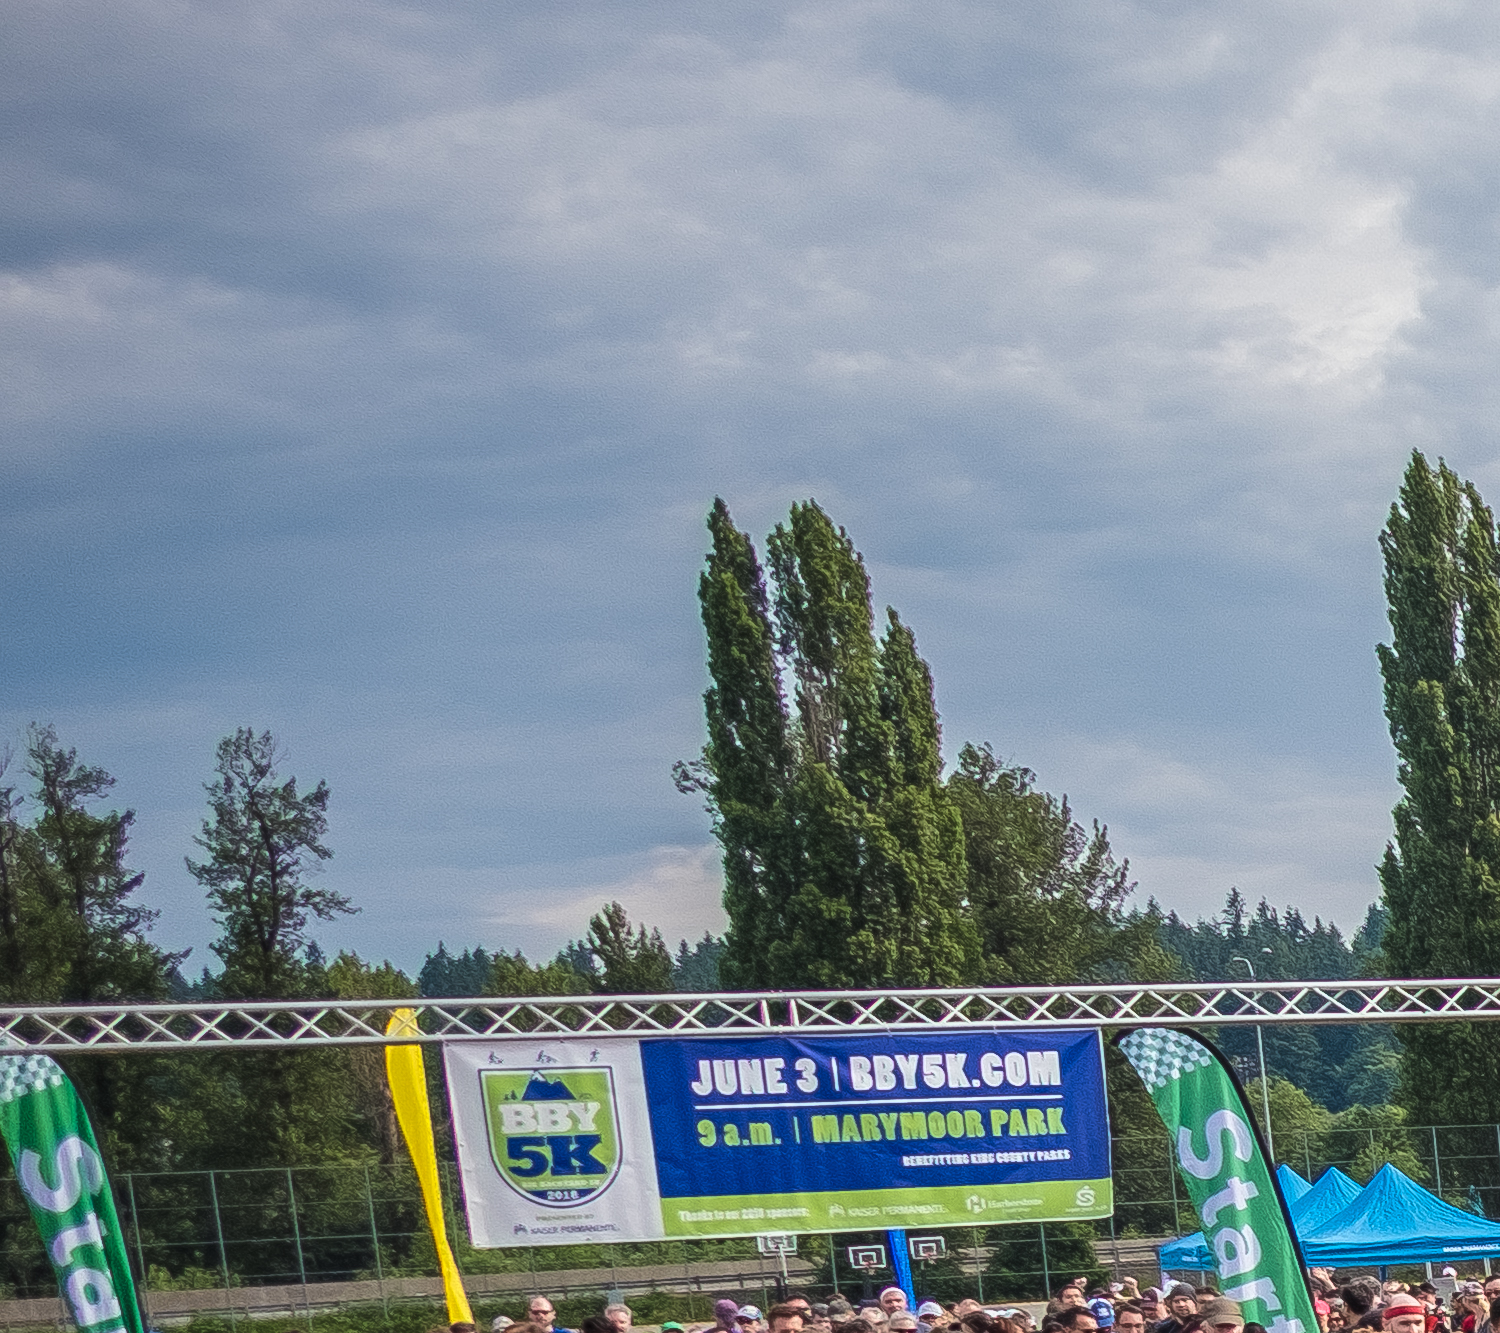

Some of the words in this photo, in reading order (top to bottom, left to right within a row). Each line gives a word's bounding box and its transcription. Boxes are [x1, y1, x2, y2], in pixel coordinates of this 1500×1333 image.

[691, 1057, 788, 1096] JUNE
[795, 1058, 818, 1093] 3
[850, 1051, 1062, 1092] BBY5K.COM
[499, 1101, 601, 1134] BBY
[697, 1119, 717, 1147] 9
[723, 1121, 782, 1147] a.m.
[811, 1109, 985, 1144] MARYMOOR
[989, 1106, 1068, 1137] PARK
[506, 1134, 608, 1178] 5K
[995, 1151, 1036, 1164] COUNTY
[1036, 1149, 1071, 1162] PARKS
[547, 1190, 579, 1201] 2018
